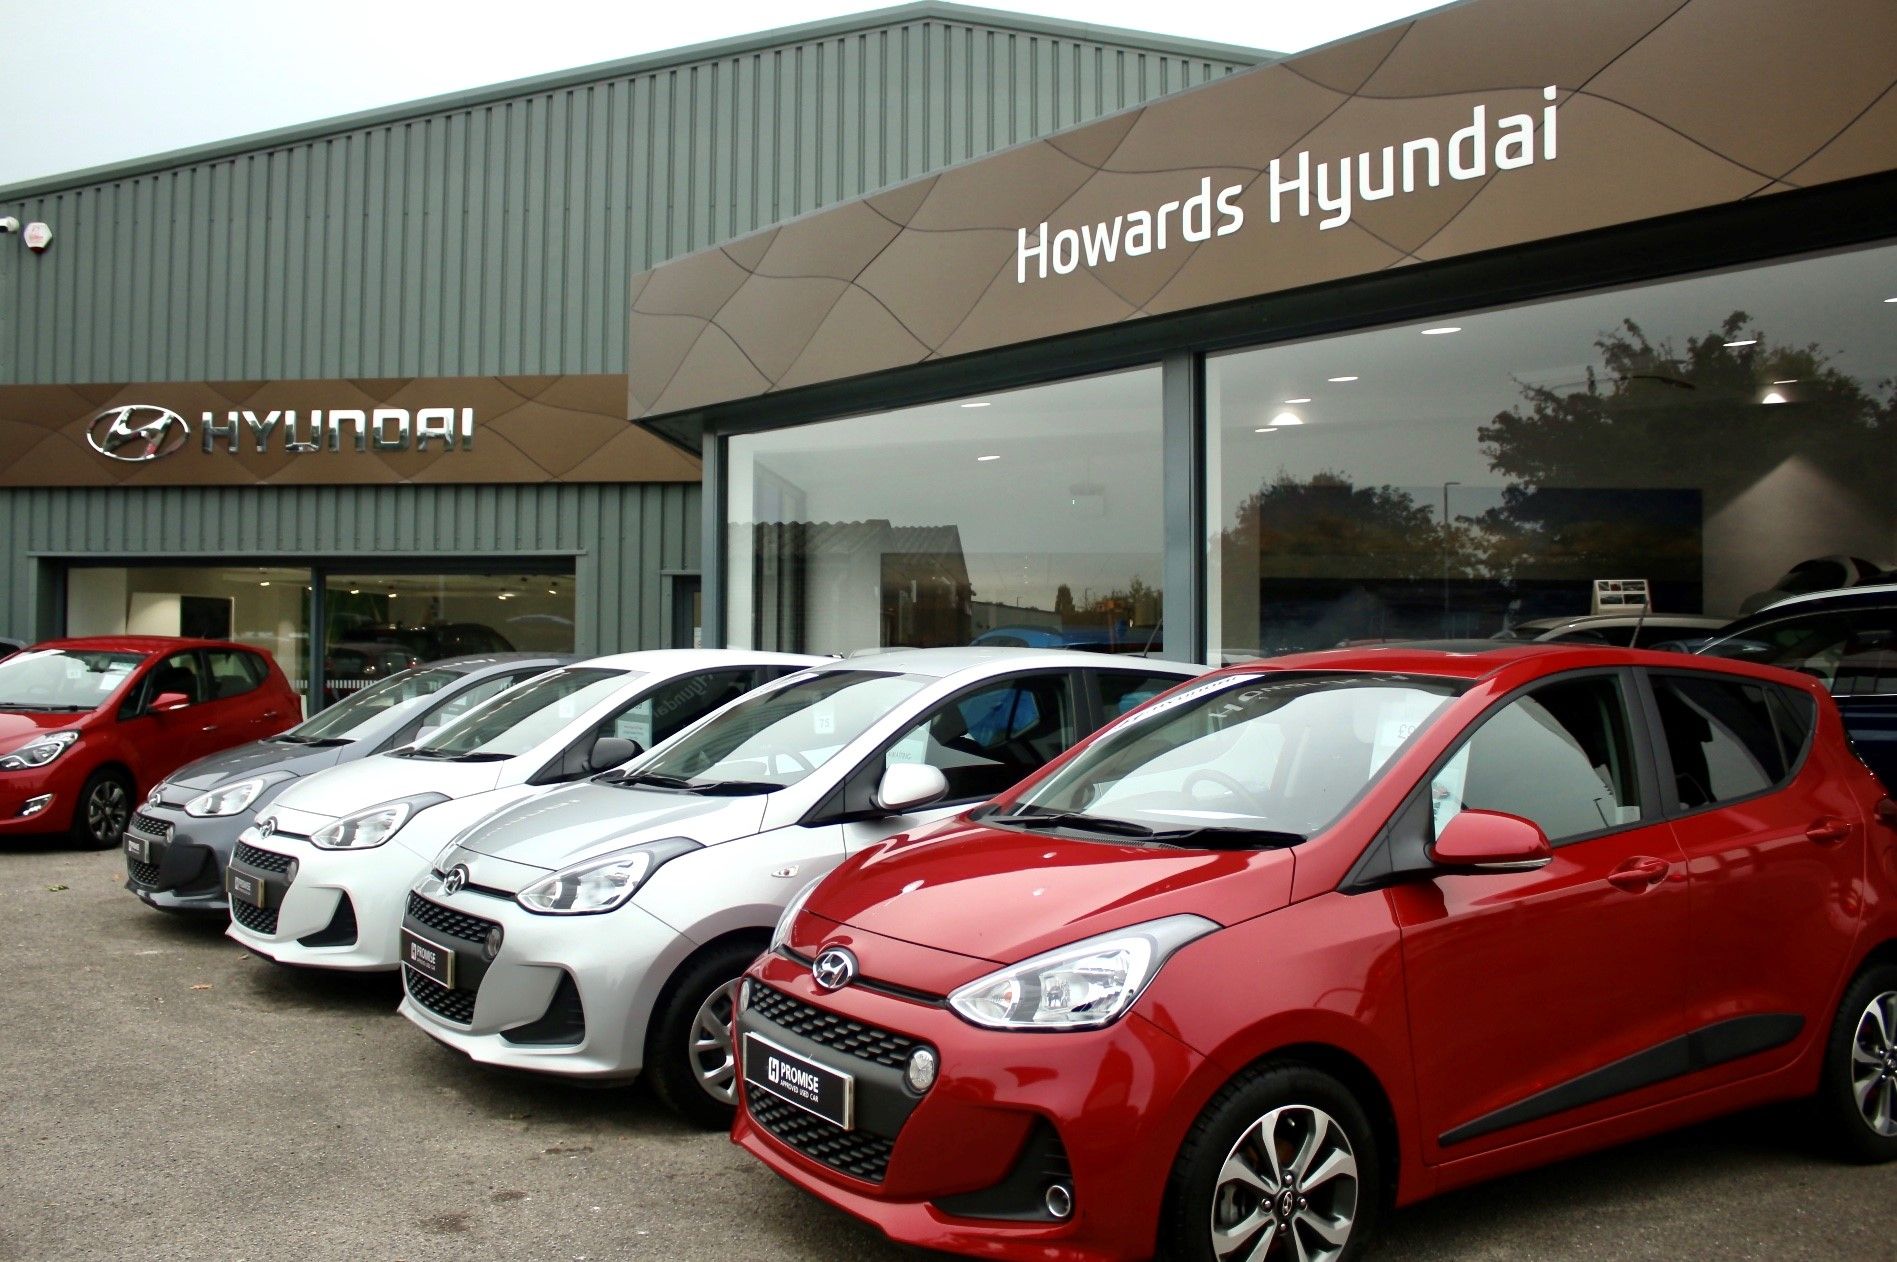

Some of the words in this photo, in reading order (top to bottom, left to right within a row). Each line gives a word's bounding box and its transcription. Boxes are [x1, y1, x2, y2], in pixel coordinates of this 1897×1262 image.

[1017, 177, 1244, 284] Howards
[1270, 84, 1557, 231] Hyundai
[201, 407, 474, 453] HYUNDAI
[780, 1062, 819, 1093] PROMISE
[780, 1080, 799, 1093] APPROVED
[810, 1093, 819, 1102] CAR
